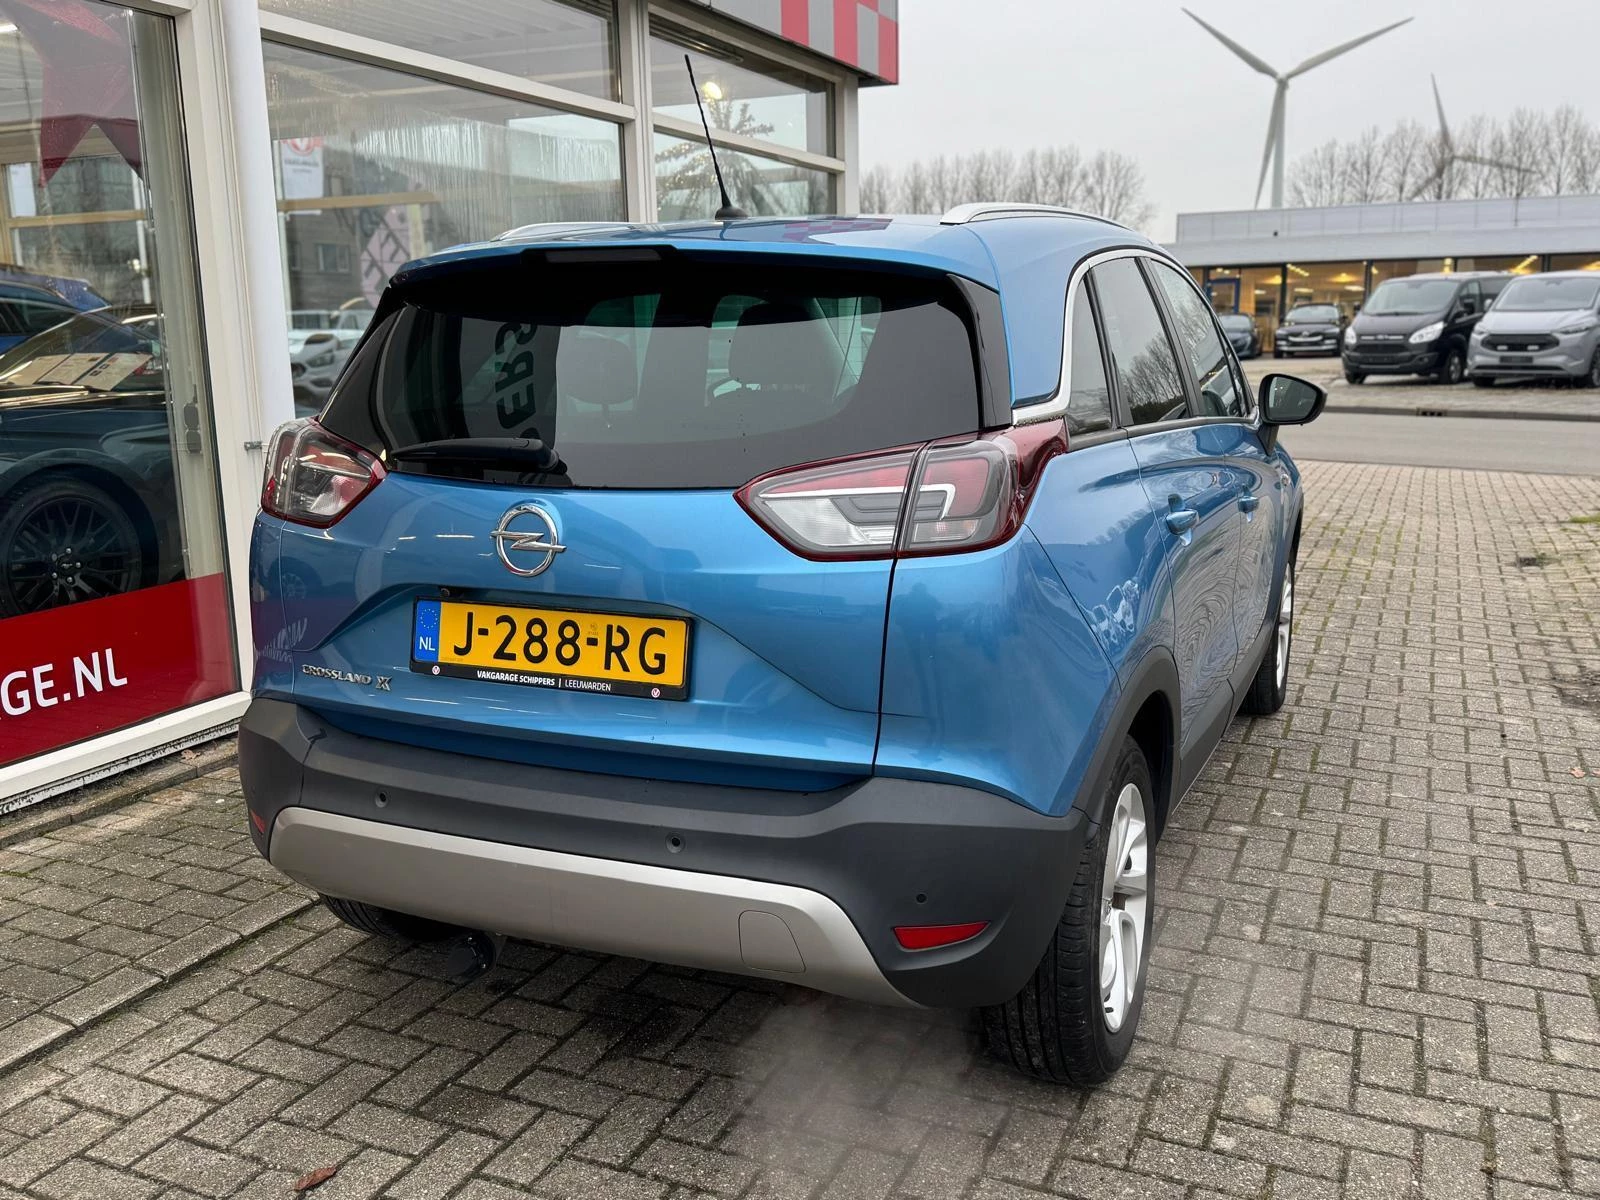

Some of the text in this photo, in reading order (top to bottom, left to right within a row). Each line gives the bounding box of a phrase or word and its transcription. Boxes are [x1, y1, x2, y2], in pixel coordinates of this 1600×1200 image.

[419, 636, 436, 651] NL
[453, 611, 667, 676] J-288-RG
[302, 664, 372, 685] CROSSLAND
[477, 670, 612, 692] VAKGARAGE SCHIPPERS LEEUWARDEN
